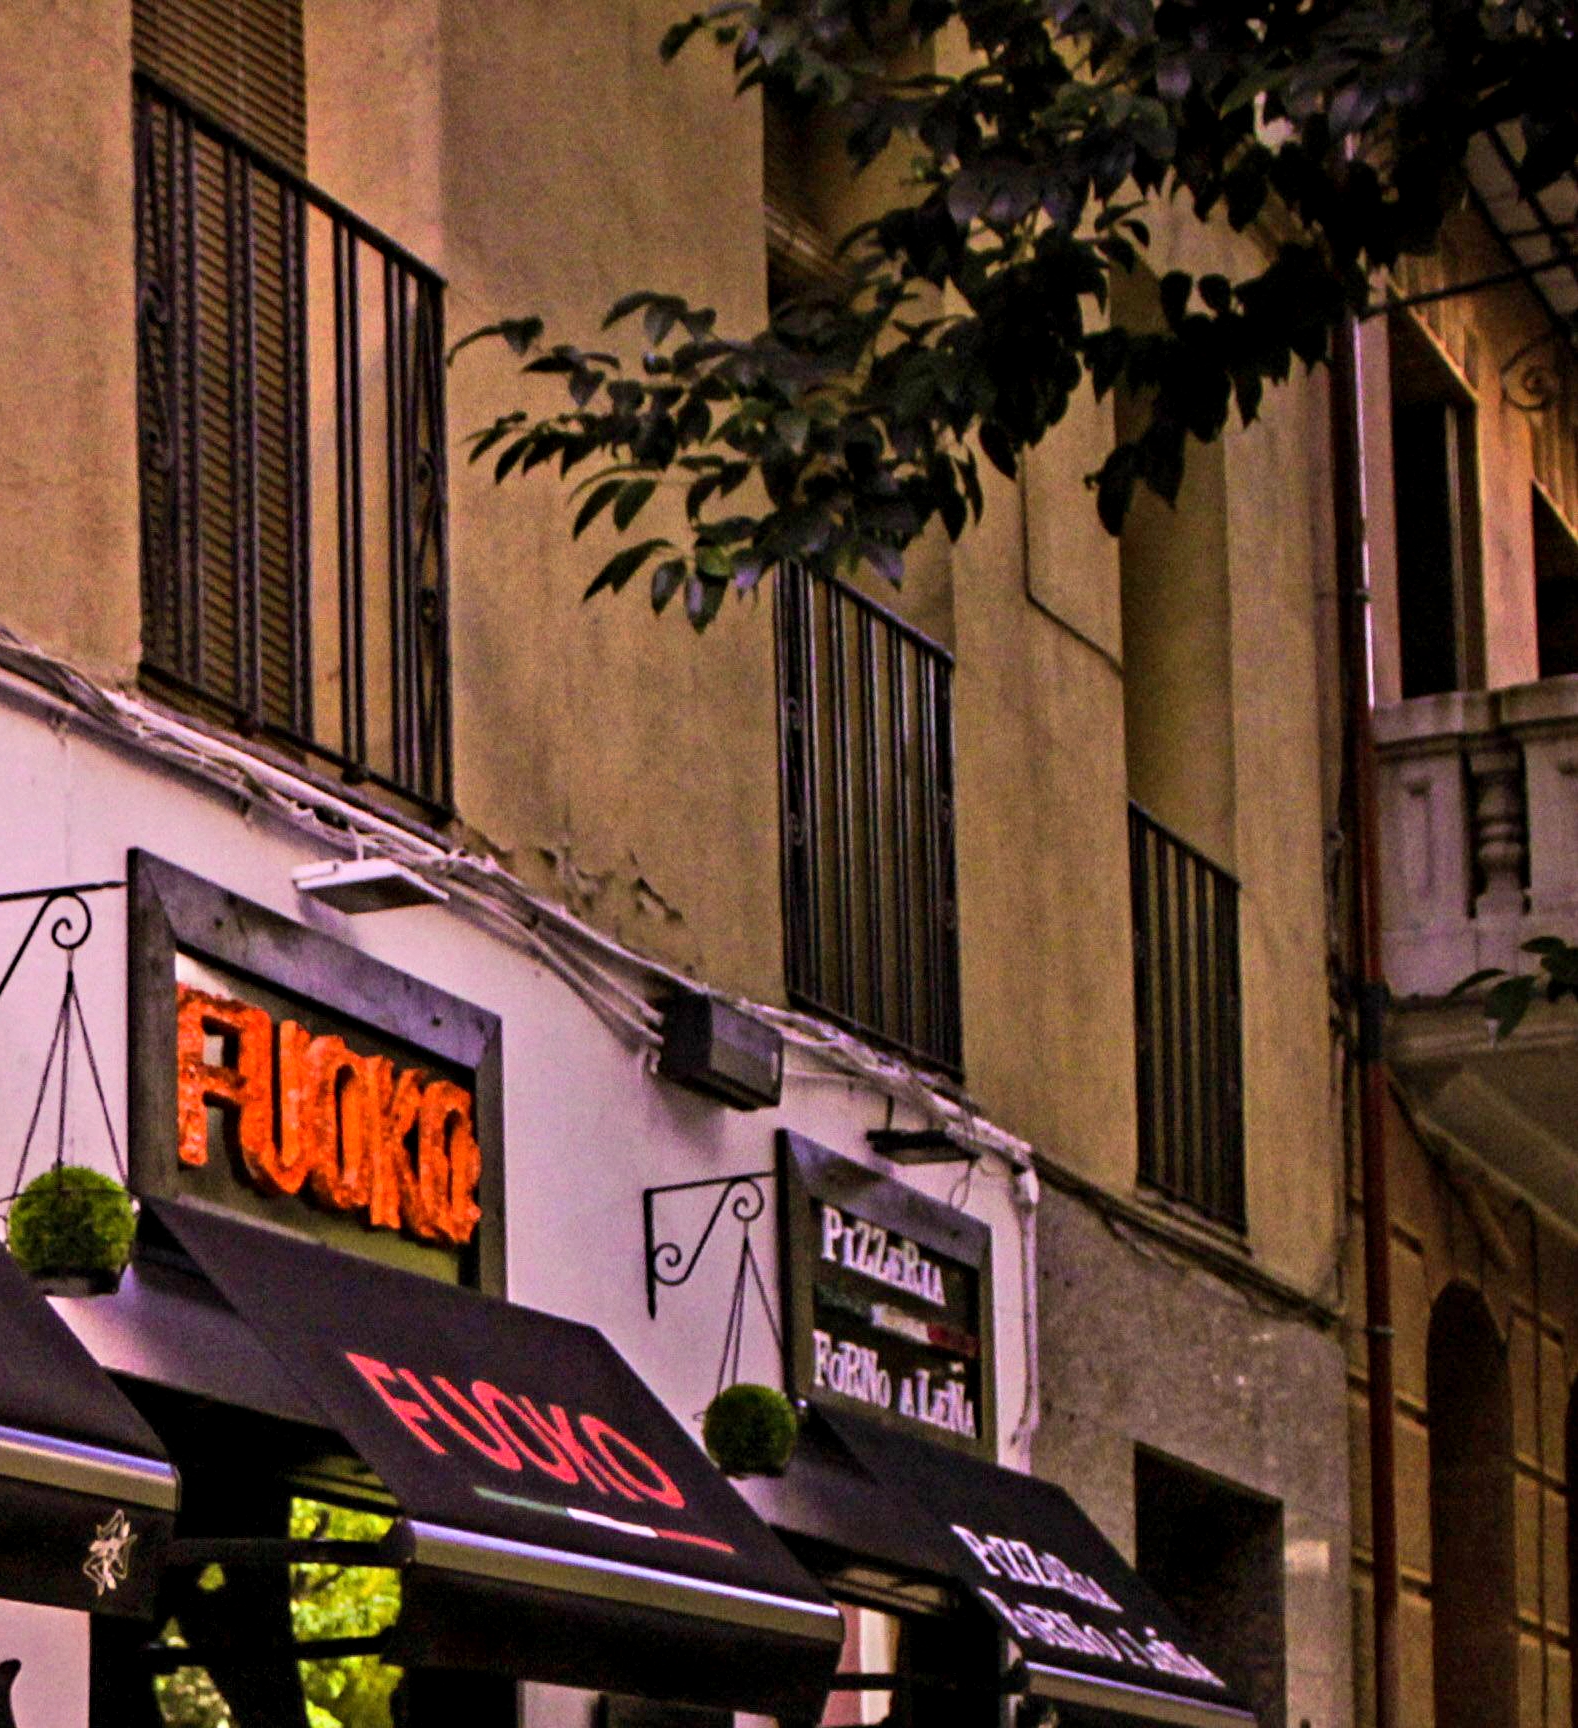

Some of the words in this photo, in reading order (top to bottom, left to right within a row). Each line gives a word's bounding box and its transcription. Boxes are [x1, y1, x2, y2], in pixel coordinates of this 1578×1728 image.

[176, 981, 482, 1244] FUOKO
[821, 1205, 946, 1307] PIZZERIA
[345, 1352, 686, 1509] FUOKO
